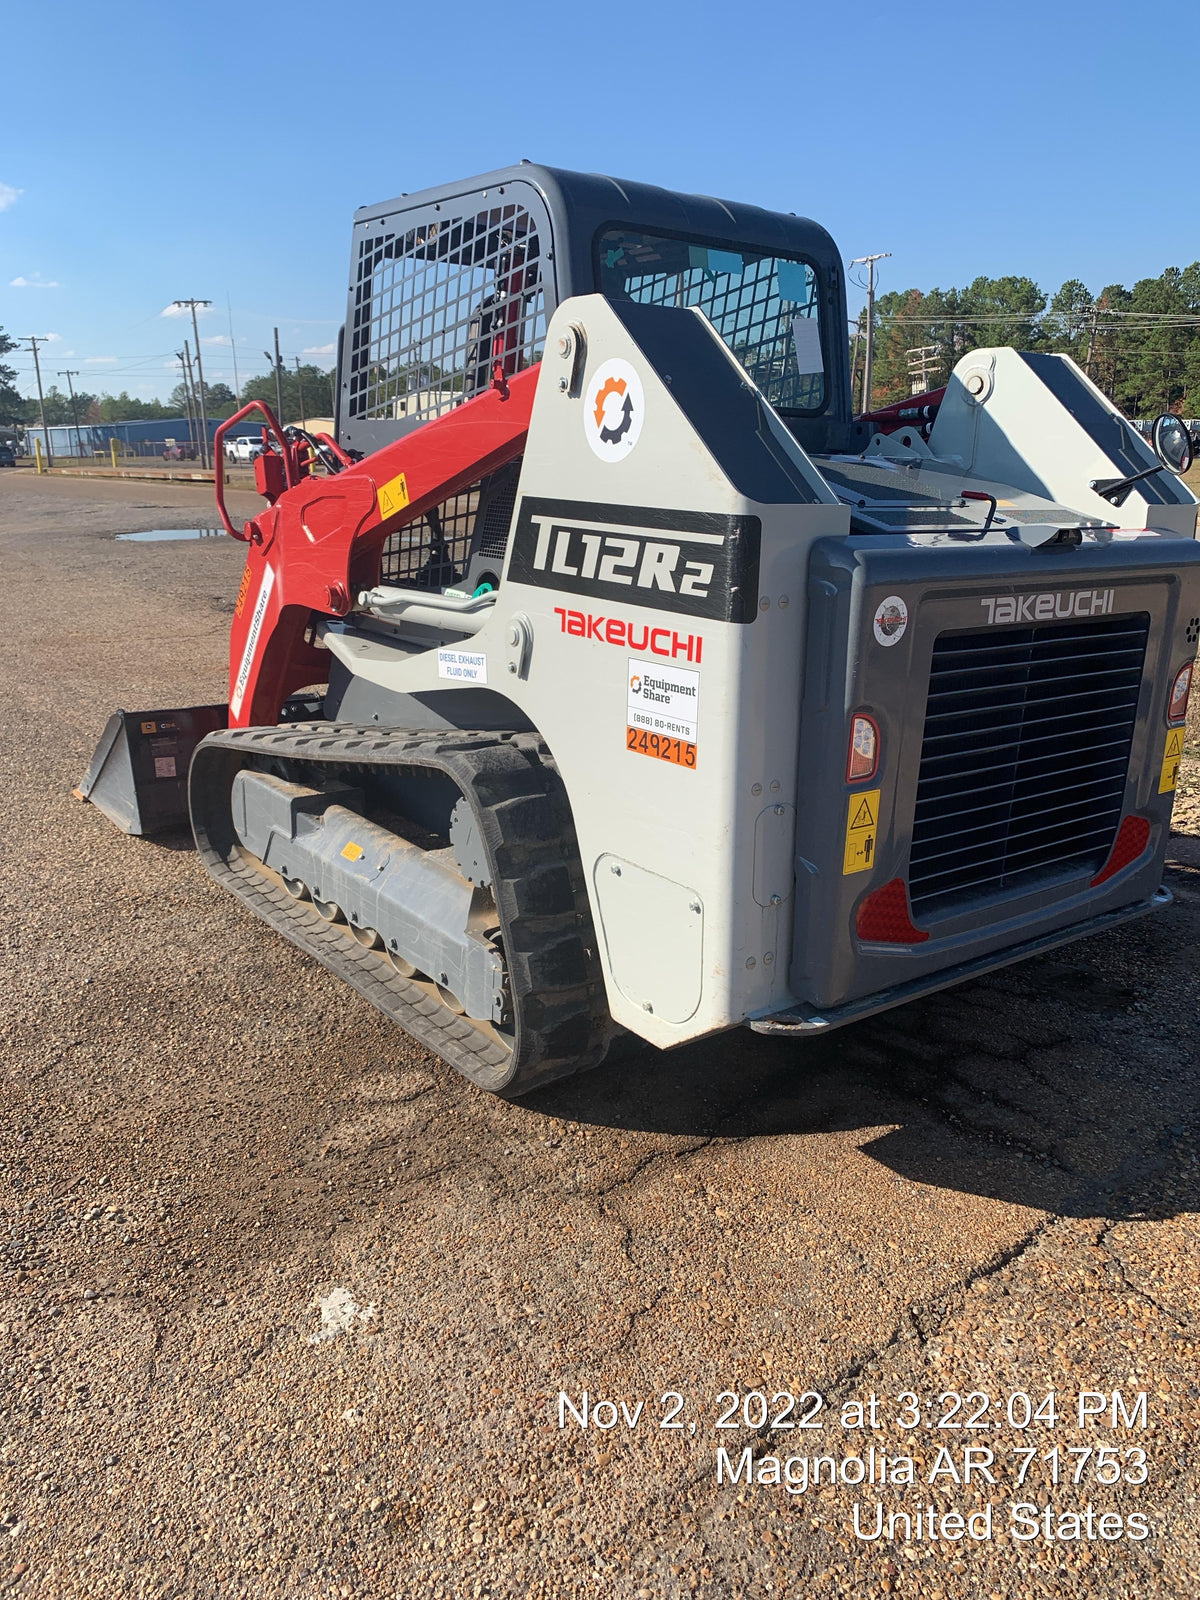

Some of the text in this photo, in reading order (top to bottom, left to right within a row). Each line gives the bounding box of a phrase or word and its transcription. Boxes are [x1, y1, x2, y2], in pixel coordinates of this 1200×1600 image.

[238, 589, 268, 688] EquipmentShare
[439, 652, 485, 667] DIESEL EXHAUST
[446, 666, 478, 679] FLUID ONLY
[643, 675, 696, 697] Equipment
[643, 688, 671, 704] Share
[633, 712, 691, 736] (888) 80-RENTS
[628, 728, 696, 767] 249215
